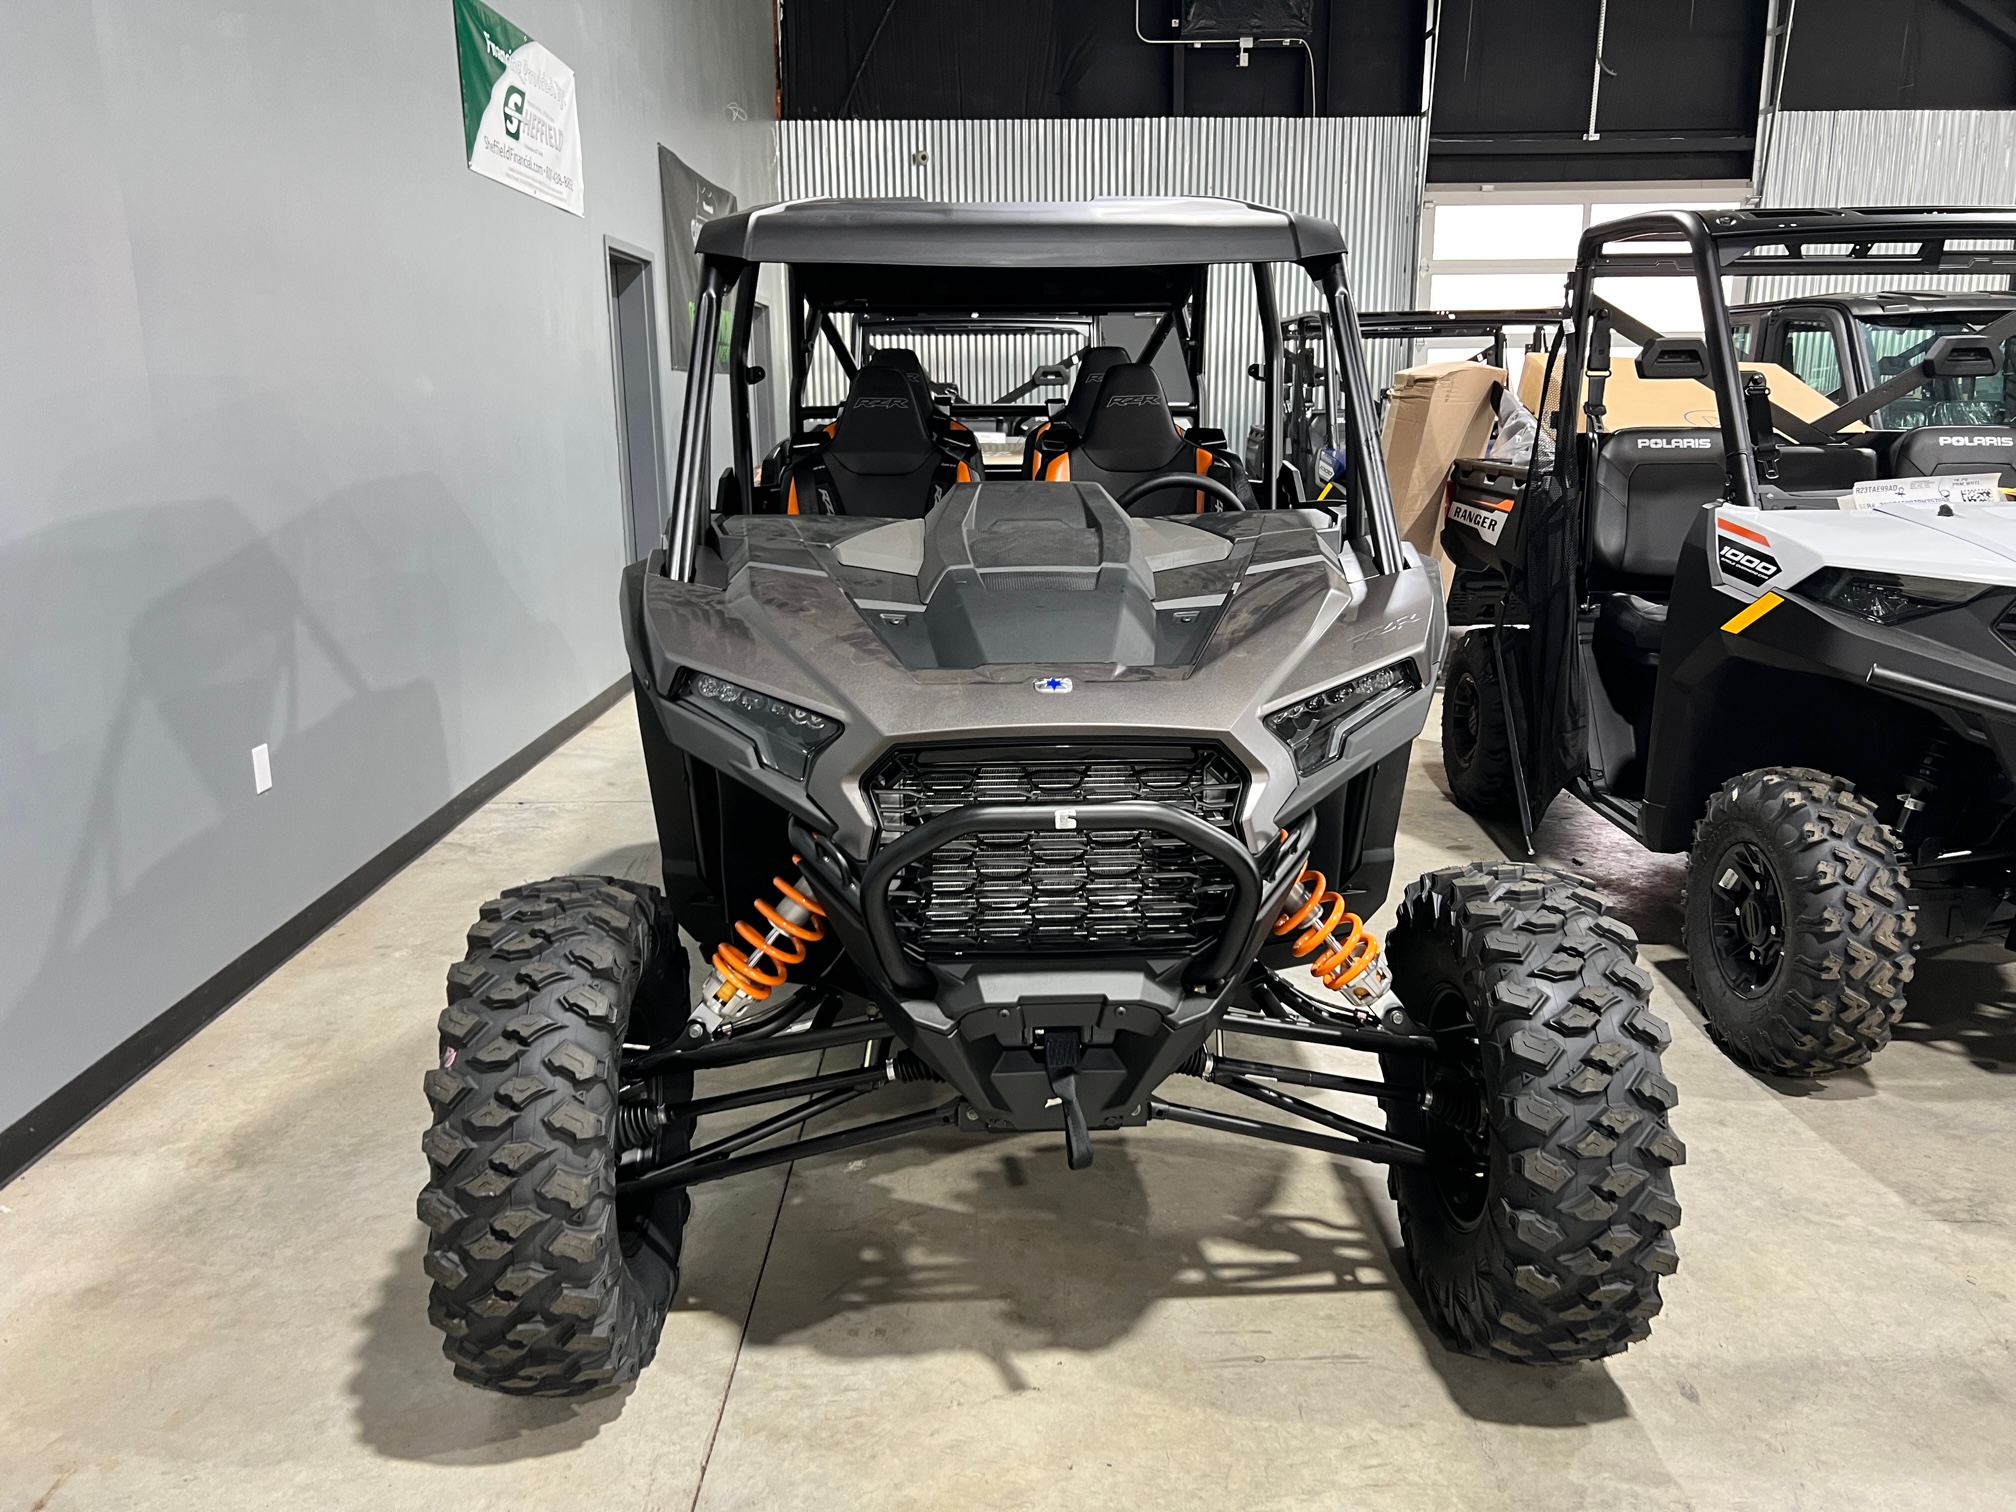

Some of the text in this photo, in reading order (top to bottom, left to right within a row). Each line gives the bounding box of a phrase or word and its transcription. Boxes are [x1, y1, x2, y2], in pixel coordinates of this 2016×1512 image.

[504, 91, 564, 152] SHEFFIELD
[853, 397, 909, 409] RZR
[1106, 395, 1160, 408] RZR
[1637, 438, 1711, 449] POLARIS
[1938, 436, 2014, 447] POLARIS
[1453, 506, 1498, 532] RANGER
[1719, 545, 1778, 575] 1000
